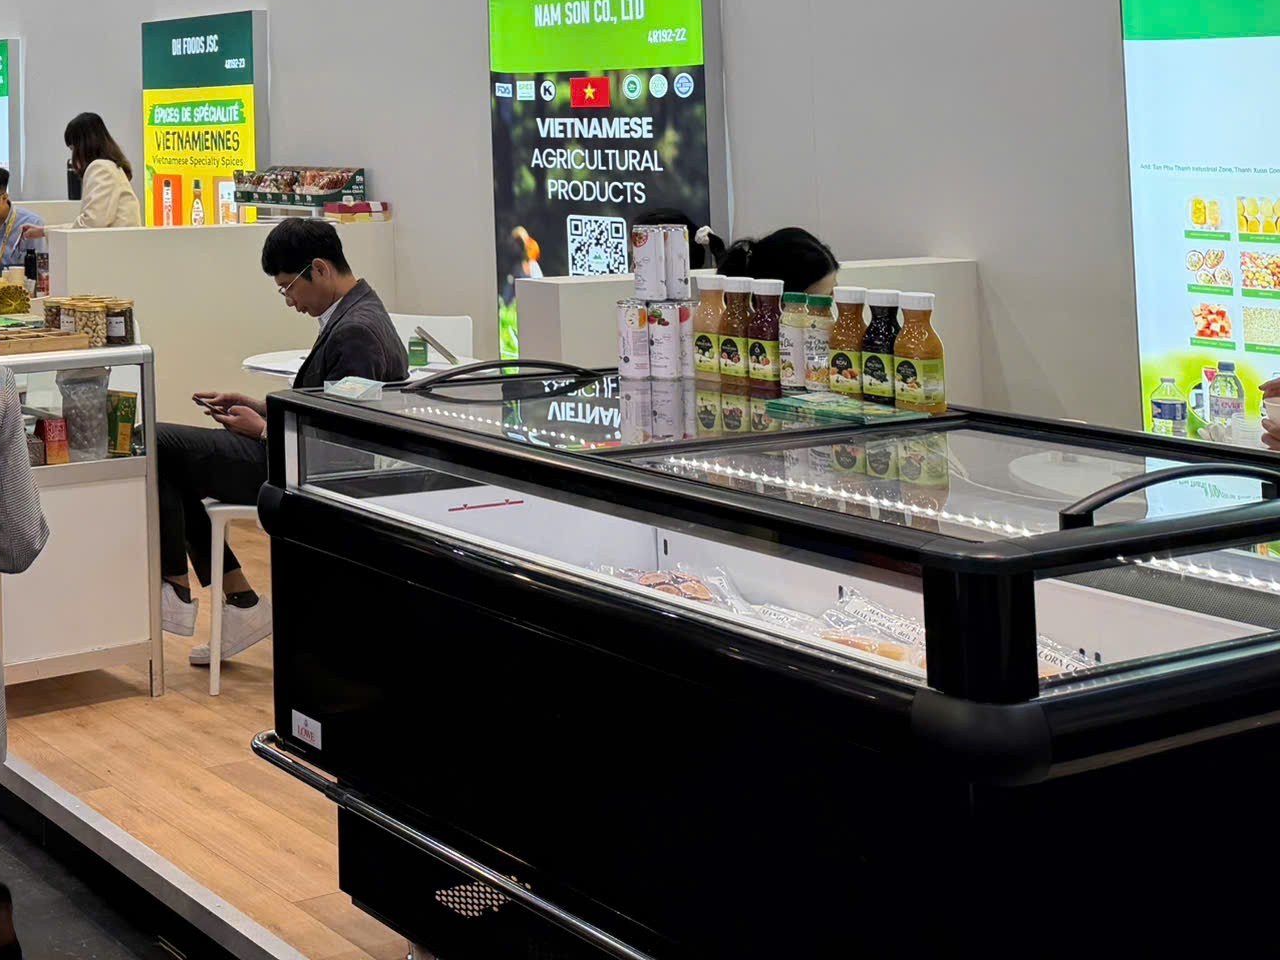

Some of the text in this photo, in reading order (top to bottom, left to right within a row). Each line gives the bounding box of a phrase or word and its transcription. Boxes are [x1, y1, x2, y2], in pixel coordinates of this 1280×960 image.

[534, 3, 562, 27] NAM
[565, 0, 590, 25] SON
[594, 0, 617, 24] CO.,
[172, 34, 219, 56] DH FOODS JSC
[648, 28, 687, 44] 4R192-22
[543, 85, 553, 96] K
[154, 102, 239, 124] ÉPICES DE SPÉCIALITÉ
[536, 117, 653, 138] VIETNAMESE
[152, 155, 243, 168] Vietnamese Specialty Spices
[531, 148, 663, 171] AGRICULTURAL
[548, 179, 646, 204] PRODUCTS
